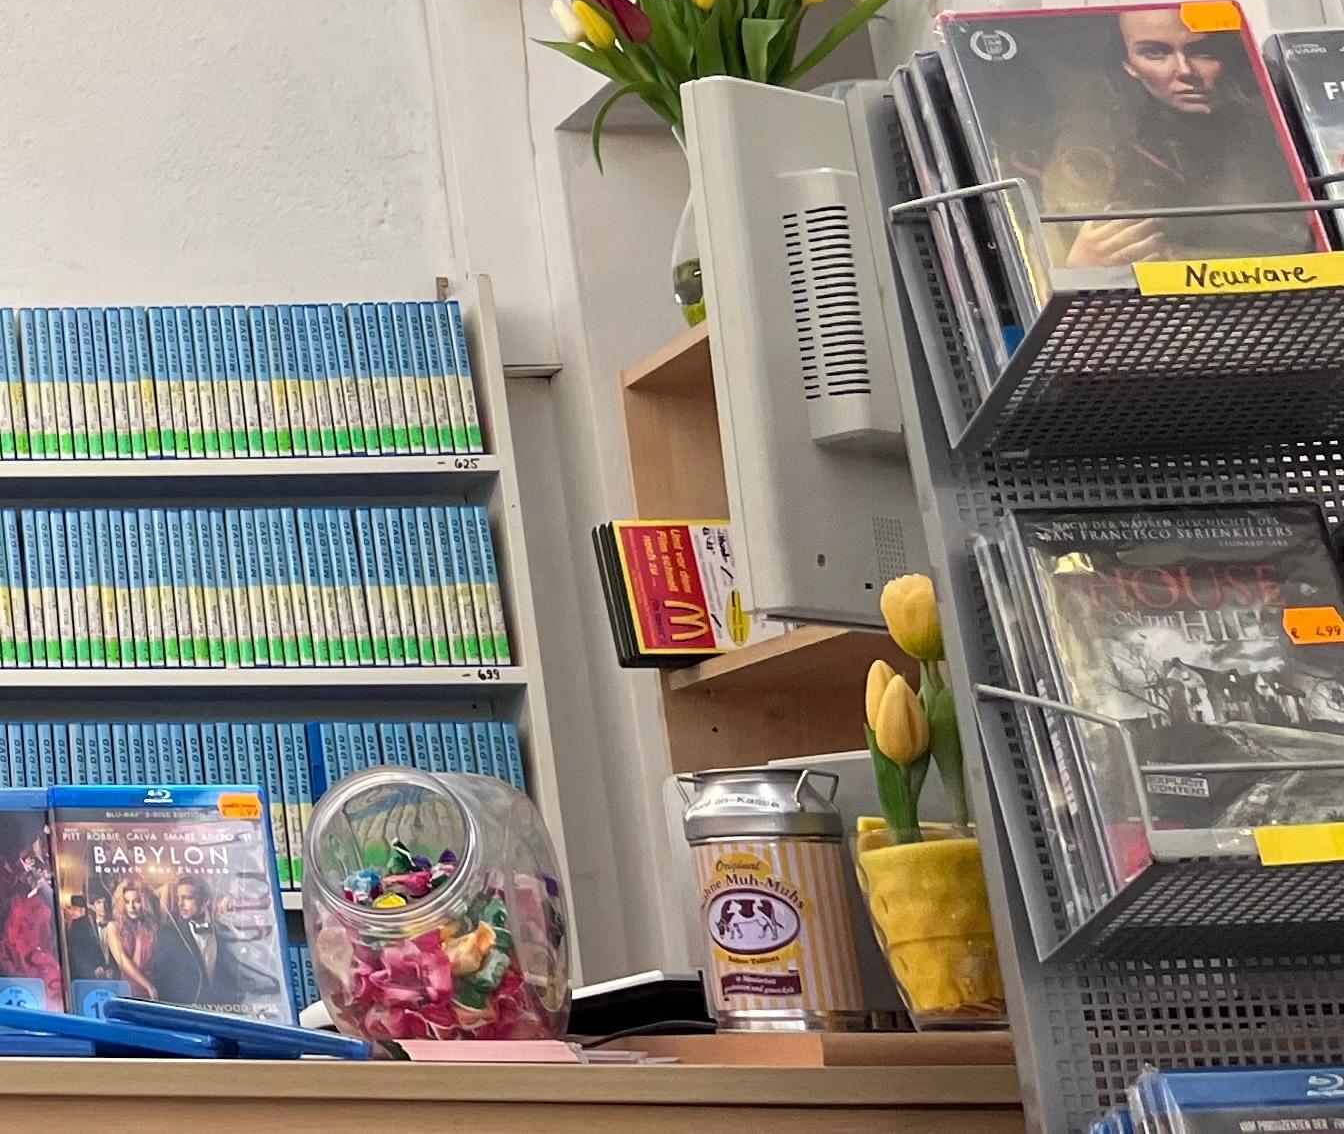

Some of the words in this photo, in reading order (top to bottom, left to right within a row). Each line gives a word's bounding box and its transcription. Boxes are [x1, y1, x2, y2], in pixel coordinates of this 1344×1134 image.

[1323, 80, 1344, 101] F
[1185, 263, 1317, 288] Neuware
[454, 458, 479, 469] 625
[1081, 529, 1170, 541] FRANCISCO
[1176, 526, 1294, 539] SERIENKILLERS
[1149, 784, 1209, 796] CONTENT
[62, 832, 80, 841] PITT
[126, 832, 157, 841] CALVA
[163, 832, 195, 841] SMART
[93, 846, 229, 866] BABYLON
[725, 873, 806, 910] Muh-Muhs
